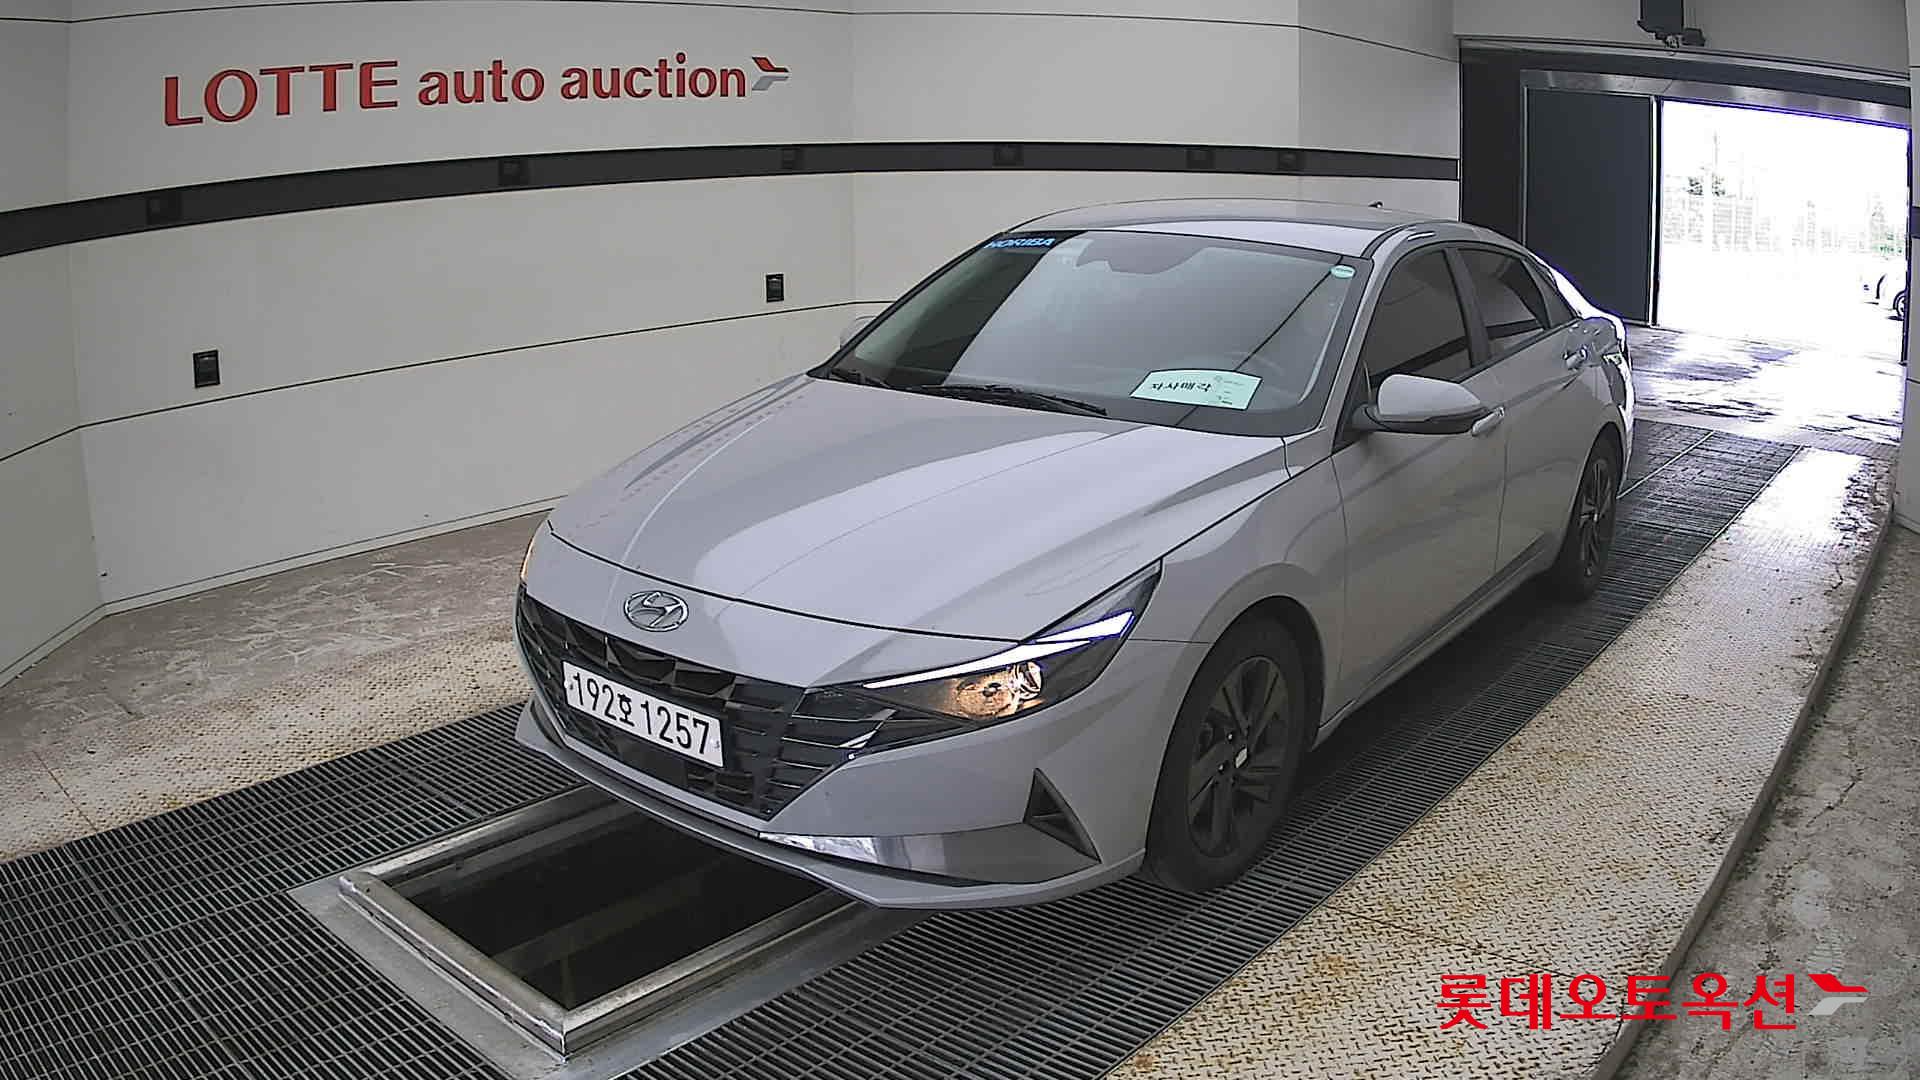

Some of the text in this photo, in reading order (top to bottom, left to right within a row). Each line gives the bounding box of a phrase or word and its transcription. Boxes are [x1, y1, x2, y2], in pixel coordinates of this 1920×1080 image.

[164, 52, 747, 126] LOTTE auto auction
